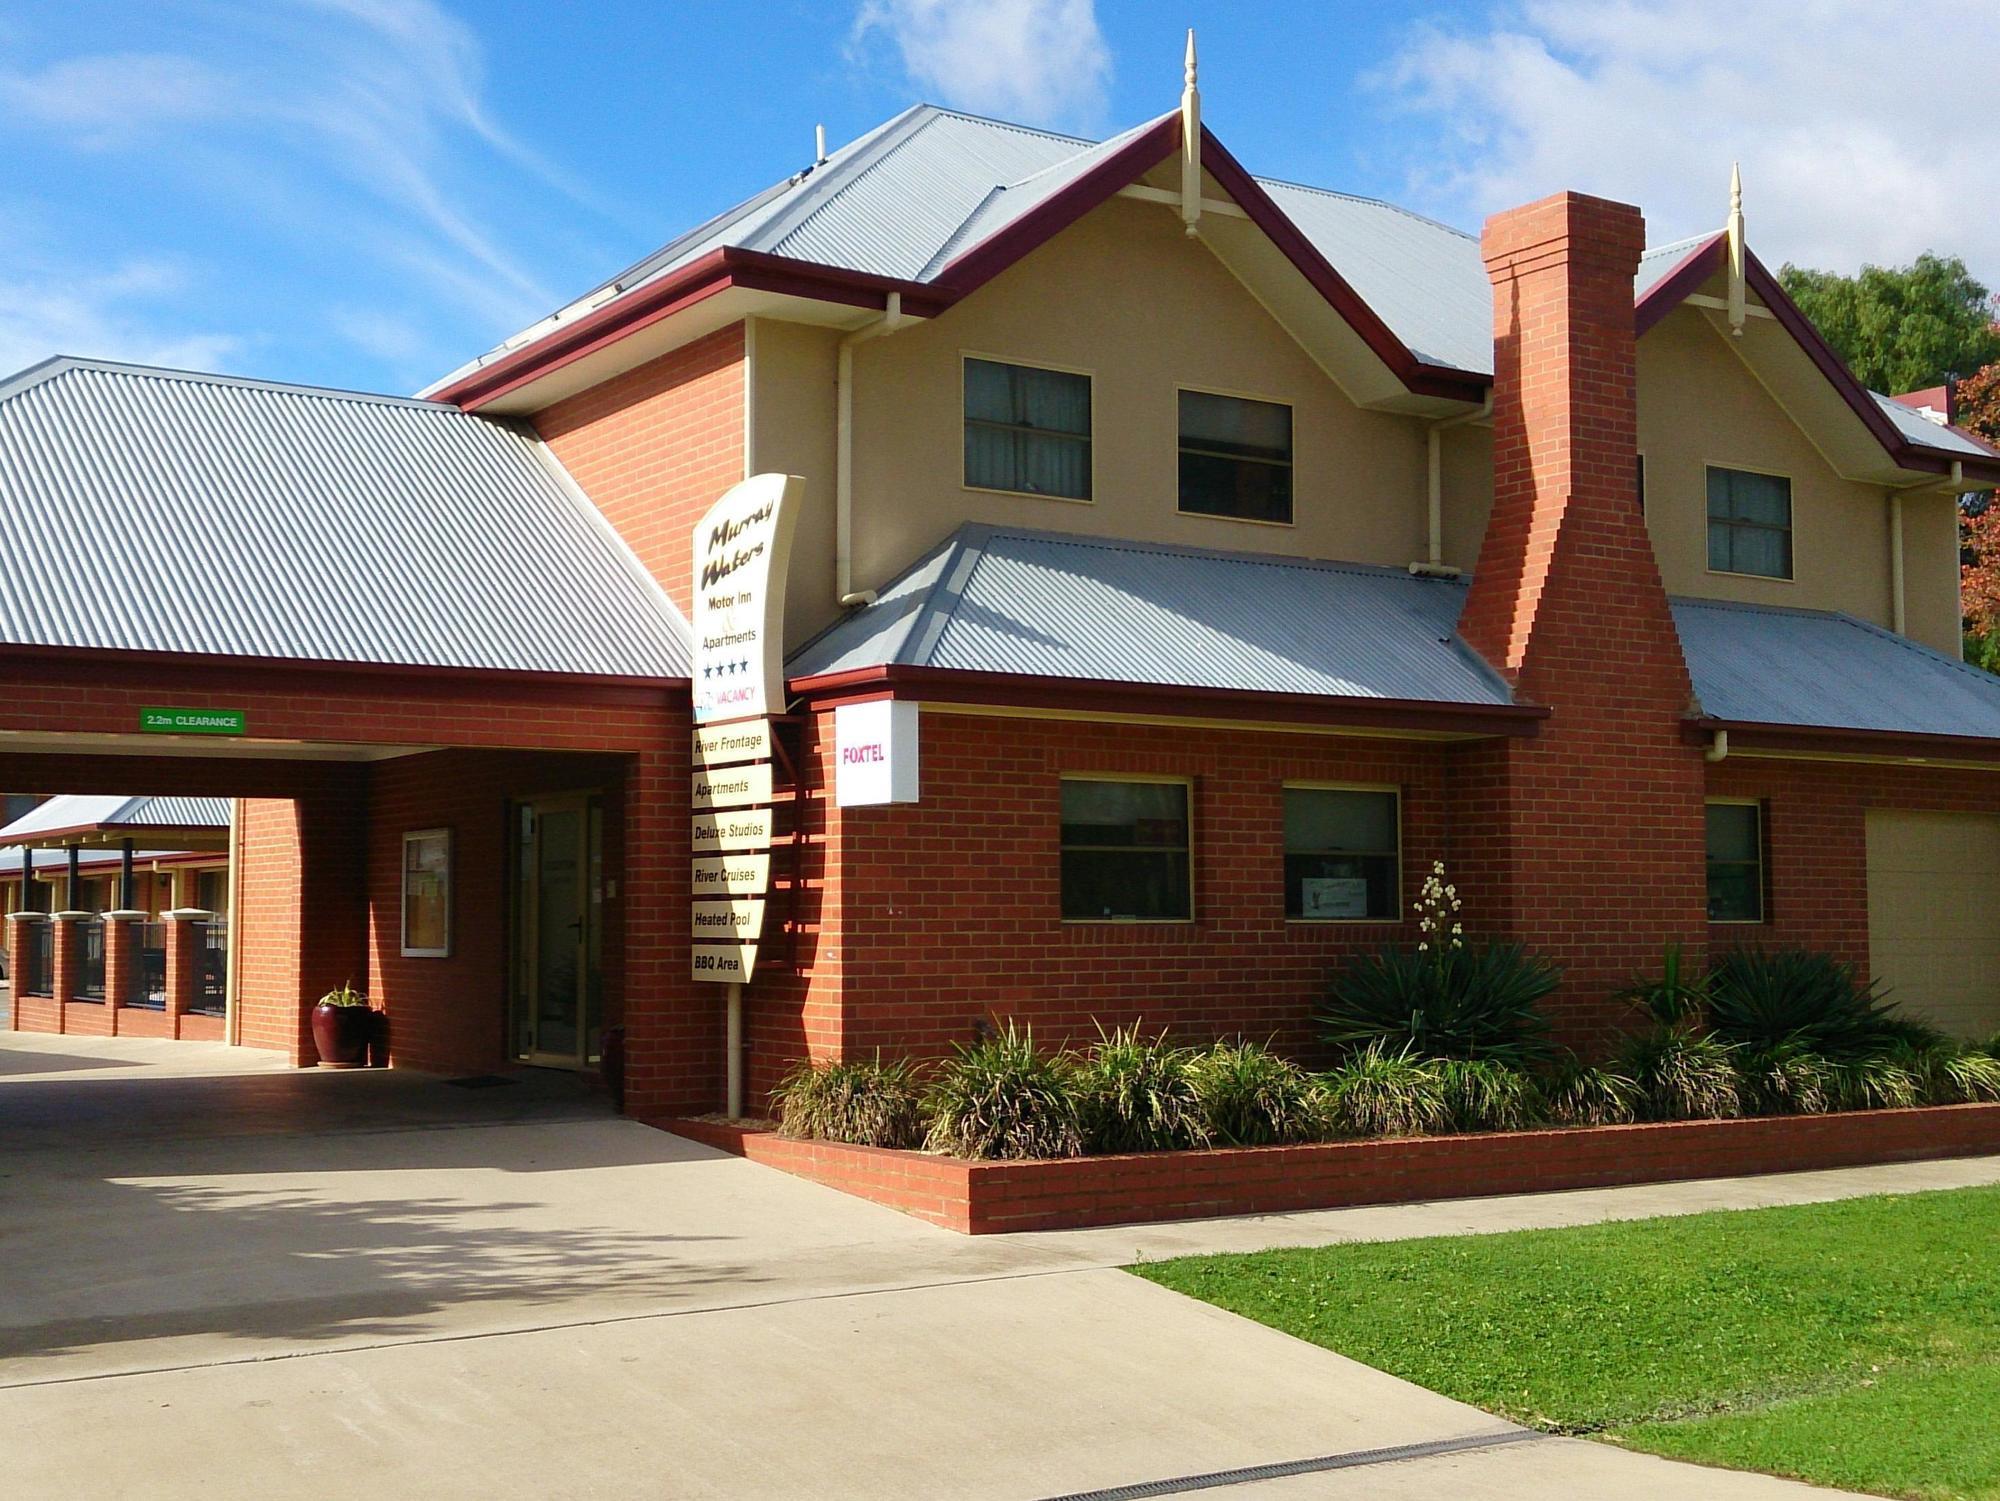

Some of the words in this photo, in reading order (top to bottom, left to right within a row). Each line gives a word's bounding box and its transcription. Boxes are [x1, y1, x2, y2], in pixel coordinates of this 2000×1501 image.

[708, 499, 774, 556] Murray
[701, 542, 764, 591] Waters
[708, 595, 735, 611] Motor
[738, 591, 752, 605] Inn
[702, 629, 757, 652] Apartments
[716, 686, 756, 705] VACANCY
[147, 715, 172, 725] 2.2m
[175, 716, 238, 727] CLEARANCE
[695, 740, 719, 754] River
[720, 734, 762, 753] Frontage
[843, 744, 884, 765] FOXTEL
[695, 779, 749, 798] Apartments
[695, 825, 726, 840] Deluxe
[728, 822, 764, 838] Studios
[695, 870, 718, 883] River
[720, 867, 756, 882] Cruises
[695, 912, 727, 926] Heated
[730, 911, 751, 926] Pool
[694, 955, 715, 971] BBQ
[717, 953, 739, 971] Area
